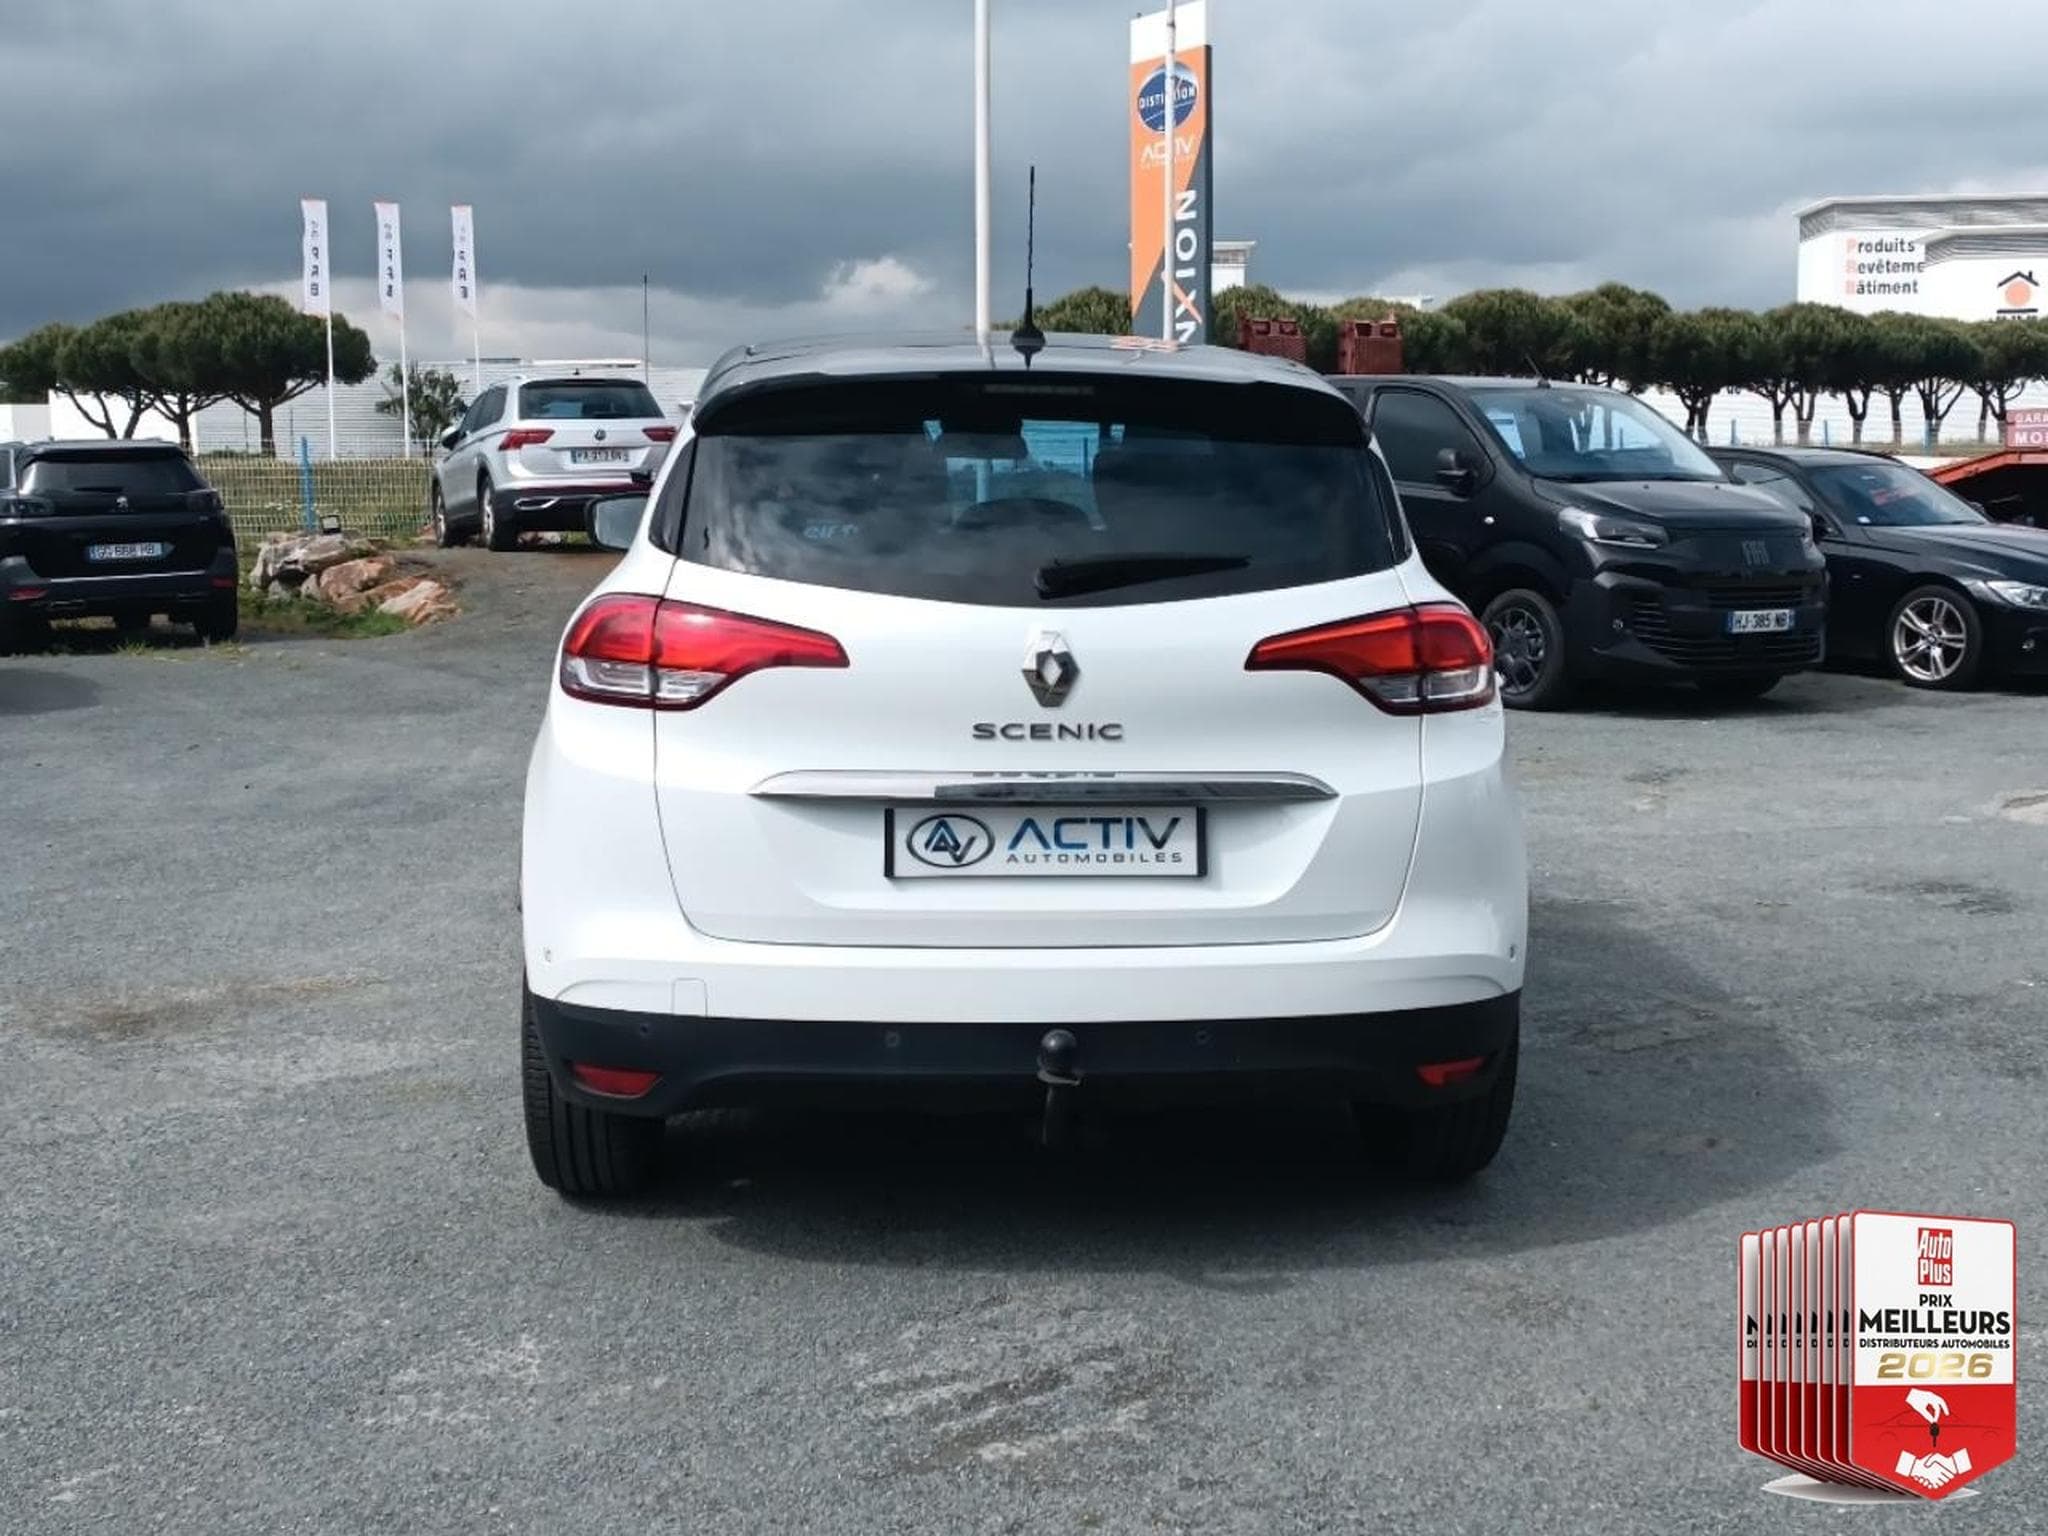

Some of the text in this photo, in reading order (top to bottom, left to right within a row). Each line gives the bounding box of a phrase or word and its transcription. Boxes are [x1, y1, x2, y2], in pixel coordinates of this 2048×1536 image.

[1846, 237, 1916, 254] Produits
[1846, 279, 1918, 295] Bâtiment
[972, 723, 1124, 741] SCENIC
[1008, 817, 1181, 850] ACTIV
[1006, 853, 1182, 863] AUTOMOBILES
